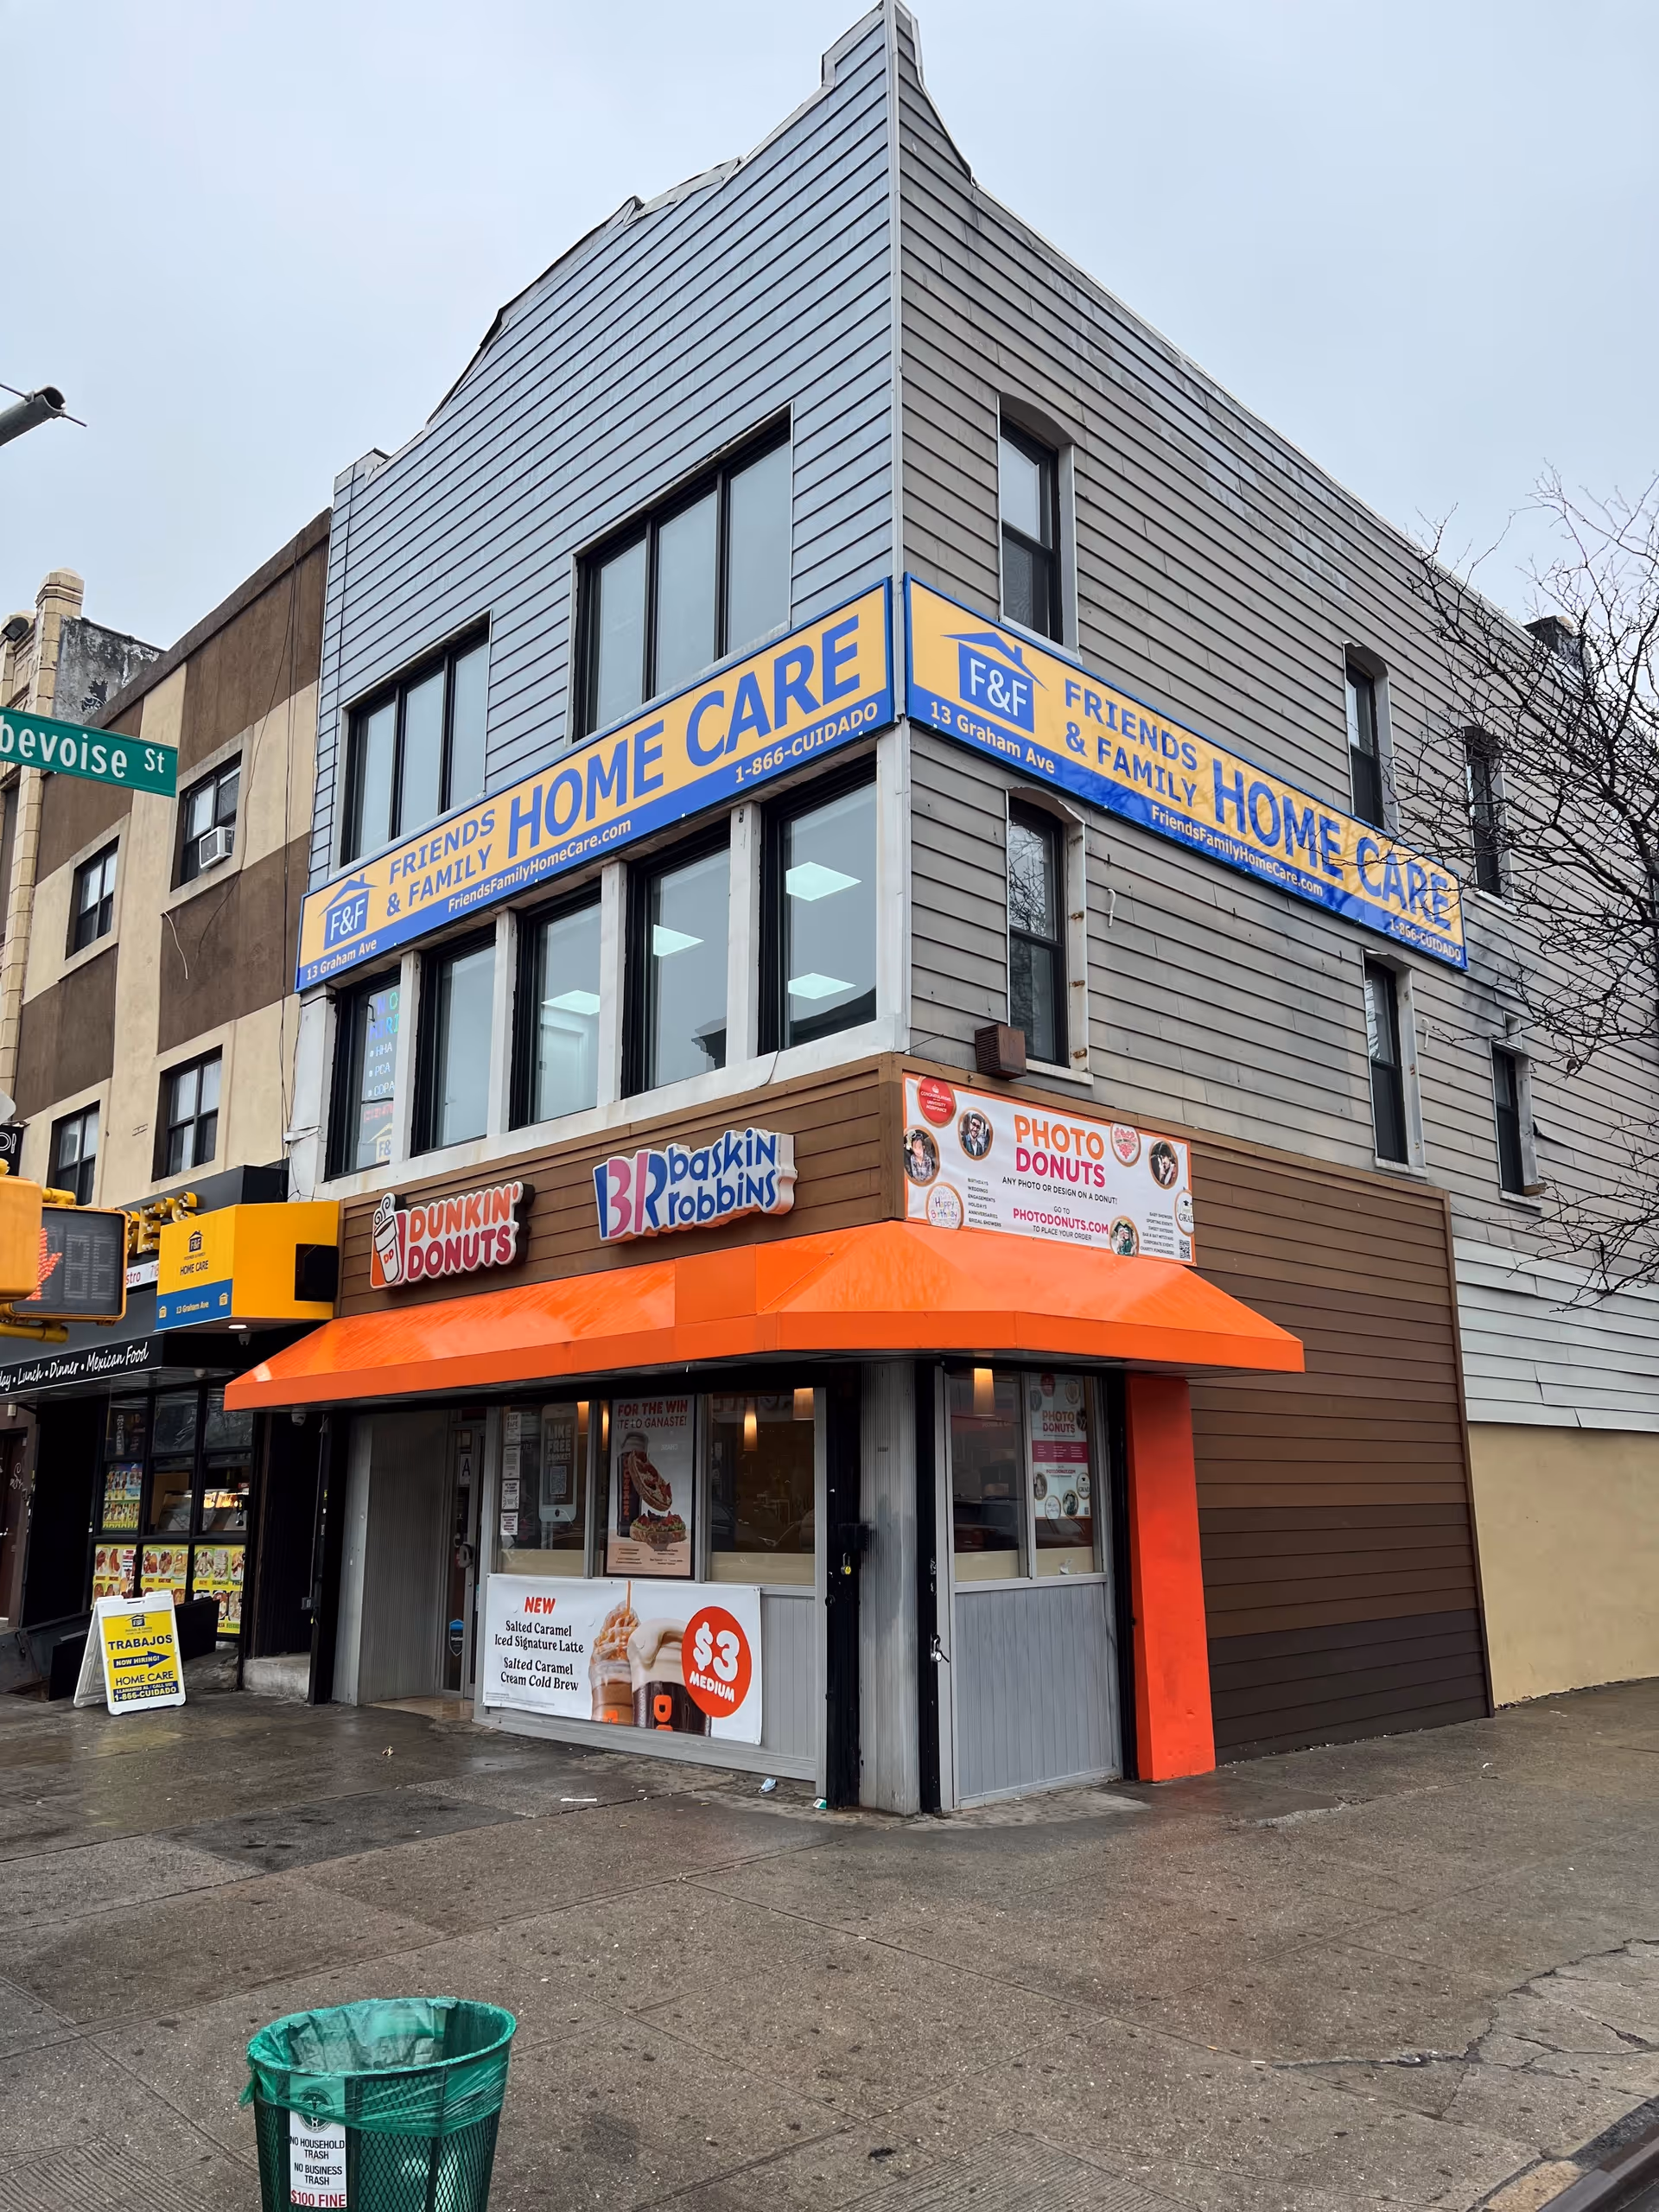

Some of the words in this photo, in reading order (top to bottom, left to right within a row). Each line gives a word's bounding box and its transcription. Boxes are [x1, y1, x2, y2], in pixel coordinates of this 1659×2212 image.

[969, 657, 1028, 717] F&F
[1065, 677, 1198, 771] FRIENDS
[508, 719, 664, 859] HOME
[686, 613, 860, 766] CARE
[734, 702, 878, 784] 1-866-CUIDADO
[931, 701, 951, 726] 13
[957, 713, 1021, 759] Graham
[1026, 747, 1055, 774] Ave
[144, 747, 165, 773] St
[1065, 721, 1087, 757] &
[1097, 735, 1198, 808] FAMILY
[389, 808, 495, 886] FRIENDS
[1152, 804, 1323, 898] FriendsFamilyHomeCare.com
[1213, 757, 1344, 881] HOME
[1357, 836, 1452, 931] CARE
[448, 819, 631, 913] FriendsFamilyHomeCare.com
[386, 892, 401, 917] &
[408, 843, 493, 907] FAMILY
[329, 898, 366, 941] F&F
[1389, 917, 1462, 962] 1-866-CUIDADO
[306, 966, 319, 981] 13
[320, 950, 356, 973] Graham
[359, 938, 377, 957] Ave
[375, 1041, 392, 1057] HHA
[1014, 1114, 1104, 1160] PHOTO
[1015, 1147, 1106, 1188] DONUTS
[967, 1185, 988, 1194] WEDDINGS
[1001, 1176, 1016, 1186] ANY
[1018, 1178, 1041, 1191] PHOTO
[1042, 1184, 1052, 1192] OR
[1053, 1185, 1077, 1197] DESIGN
[1077, 1190, 1088, 1198] ON
[410, 1185, 518, 1243] DUNKIN'
[1053, 1205, 1062, 1214] GO
[1013, 1207, 1109, 1235] PHOTODONUTS.COM
[1033, 1224, 1040, 1233] TO
[1041, 1226, 1058, 1236] PLACE
[1058, 1229, 1073, 1238] YOUR
[1074, 1231, 1092, 1242] ORDER
[383, 1248, 395, 1265] DD
[407, 1224, 512, 1280] DONUTS
[180, 1262, 195, 1276] HOME
[195, 1260, 209, 1272] CARE
[175, 1306, 182, 1314] 13
[182, 1303, 200, 1313] Graham
[200, 1301, 209, 1310] Ave
[17, 1363, 44, 1385] Lunch
[49, 1359, 79, 1379] Dinner
[86, 1349, 125, 1372] Mexican
[125, 1342, 149, 1365] Food
[618, 1402, 639, 1417] FOR
[641, 1402, 664, 1415] THE
[664, 1399, 688, 1414] WIN
[1042, 1409, 1075, 1423] PHOTO
[547, 1424, 572, 1440] LIKE
[631, 1418, 642, 1429] LO
[644, 1415, 688, 1428] GANASTE!
[1042, 1422, 1076, 1433] DONUTS
[547, 1440, 571, 1453] FREE
[524, 1596, 556, 1615] NEW
[505, 1620, 532, 1635] Salted
[534, 1621, 572, 1637] Caramel
[108, 1635, 173, 1650] TRABAJOS
[494, 1634, 513, 1647] Iced
[515, 1636, 557, 1652] Signature
[559, 1639, 584, 1654] Latte
[693, 1621, 740, 1682] $3
[116, 1658, 132, 1667] NOW
[133, 1656, 160, 1665] HIRING!
[504, 1656, 533, 1672] Salted
[535, 1658, 573, 1675] Caramel
[116, 1674, 145, 1687] HOME
[147, 1670, 174, 1682] CARE
[500, 1671, 527, 1687] Cream
[529, 1674, 552, 1689] Cold
[553, 1677, 579, 1692] Brew
[690, 1670, 735, 1704] MEDIUM
[114, 1686, 176, 1702] 1-866-CUIDADO
[289, 2135, 299, 2146] NO
[300, 2138, 345, 2150] HOUSEHOLD
[304, 2149, 329, 2160] TRASH
[294, 2162, 303, 2172] NO
[304, 2164, 343, 2176] BUSINESS
[304, 2175, 330, 2186] TRASH
[291, 2189, 315, 2206] $100
[318, 2194, 346, 2207] FINE
